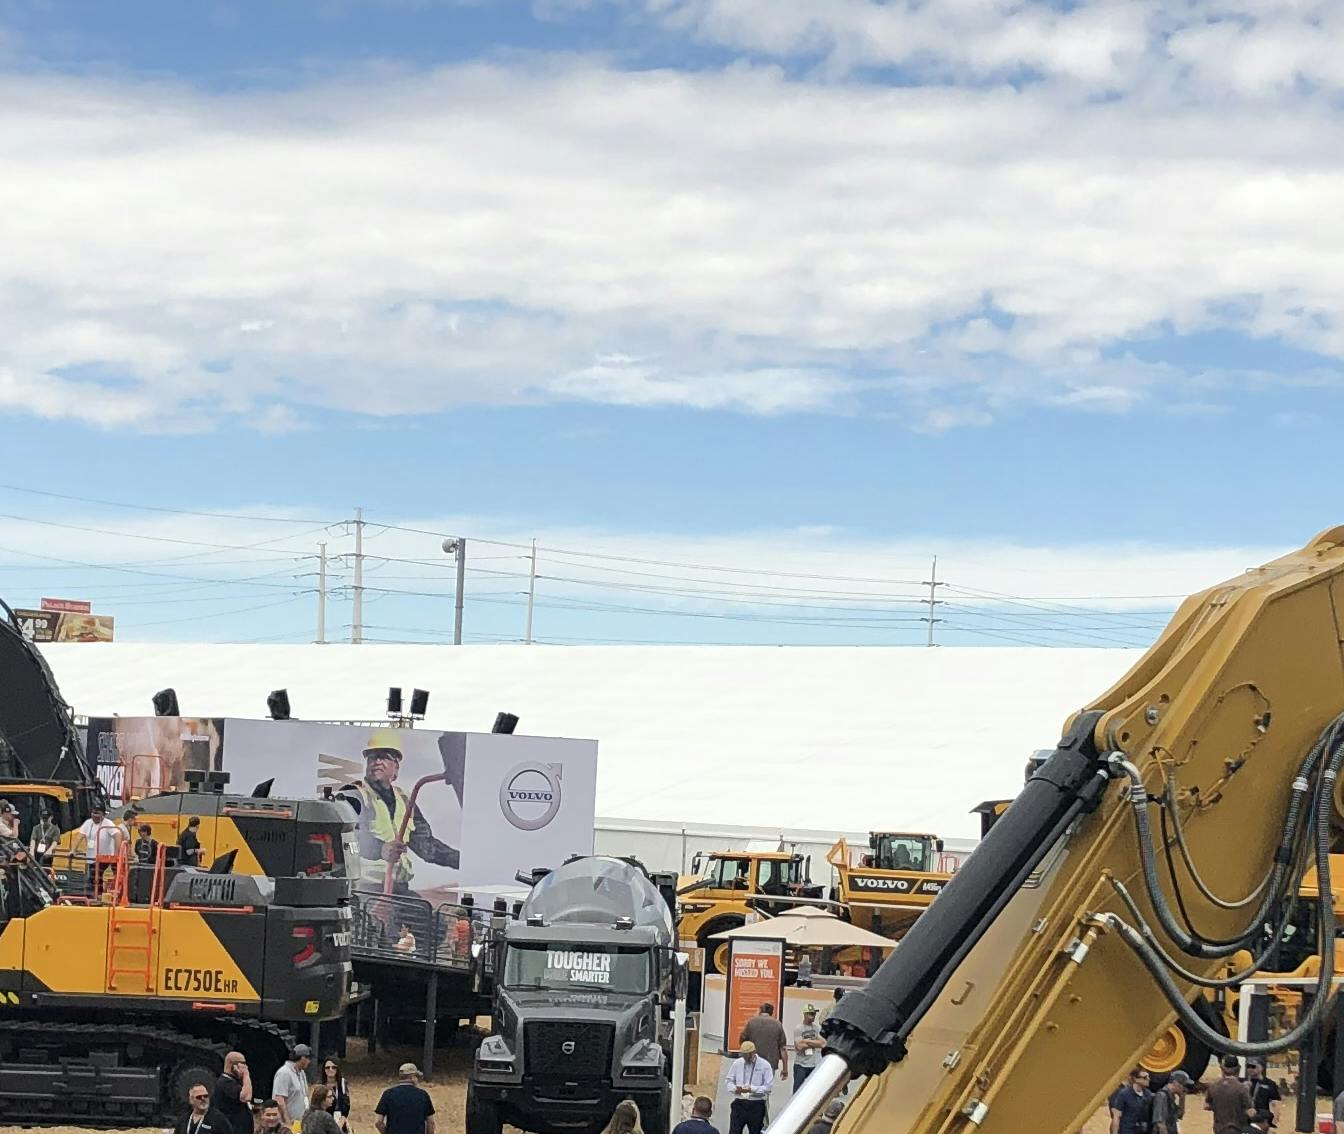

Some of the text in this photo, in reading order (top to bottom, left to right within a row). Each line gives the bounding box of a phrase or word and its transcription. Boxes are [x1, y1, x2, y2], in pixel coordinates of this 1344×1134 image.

[508, 791, 553, 801] VOLVO
[855, 878, 908, 889] VOLVO
[546, 950, 611, 971] TOUGHER
[570, 969, 610, 983] SMARTER
